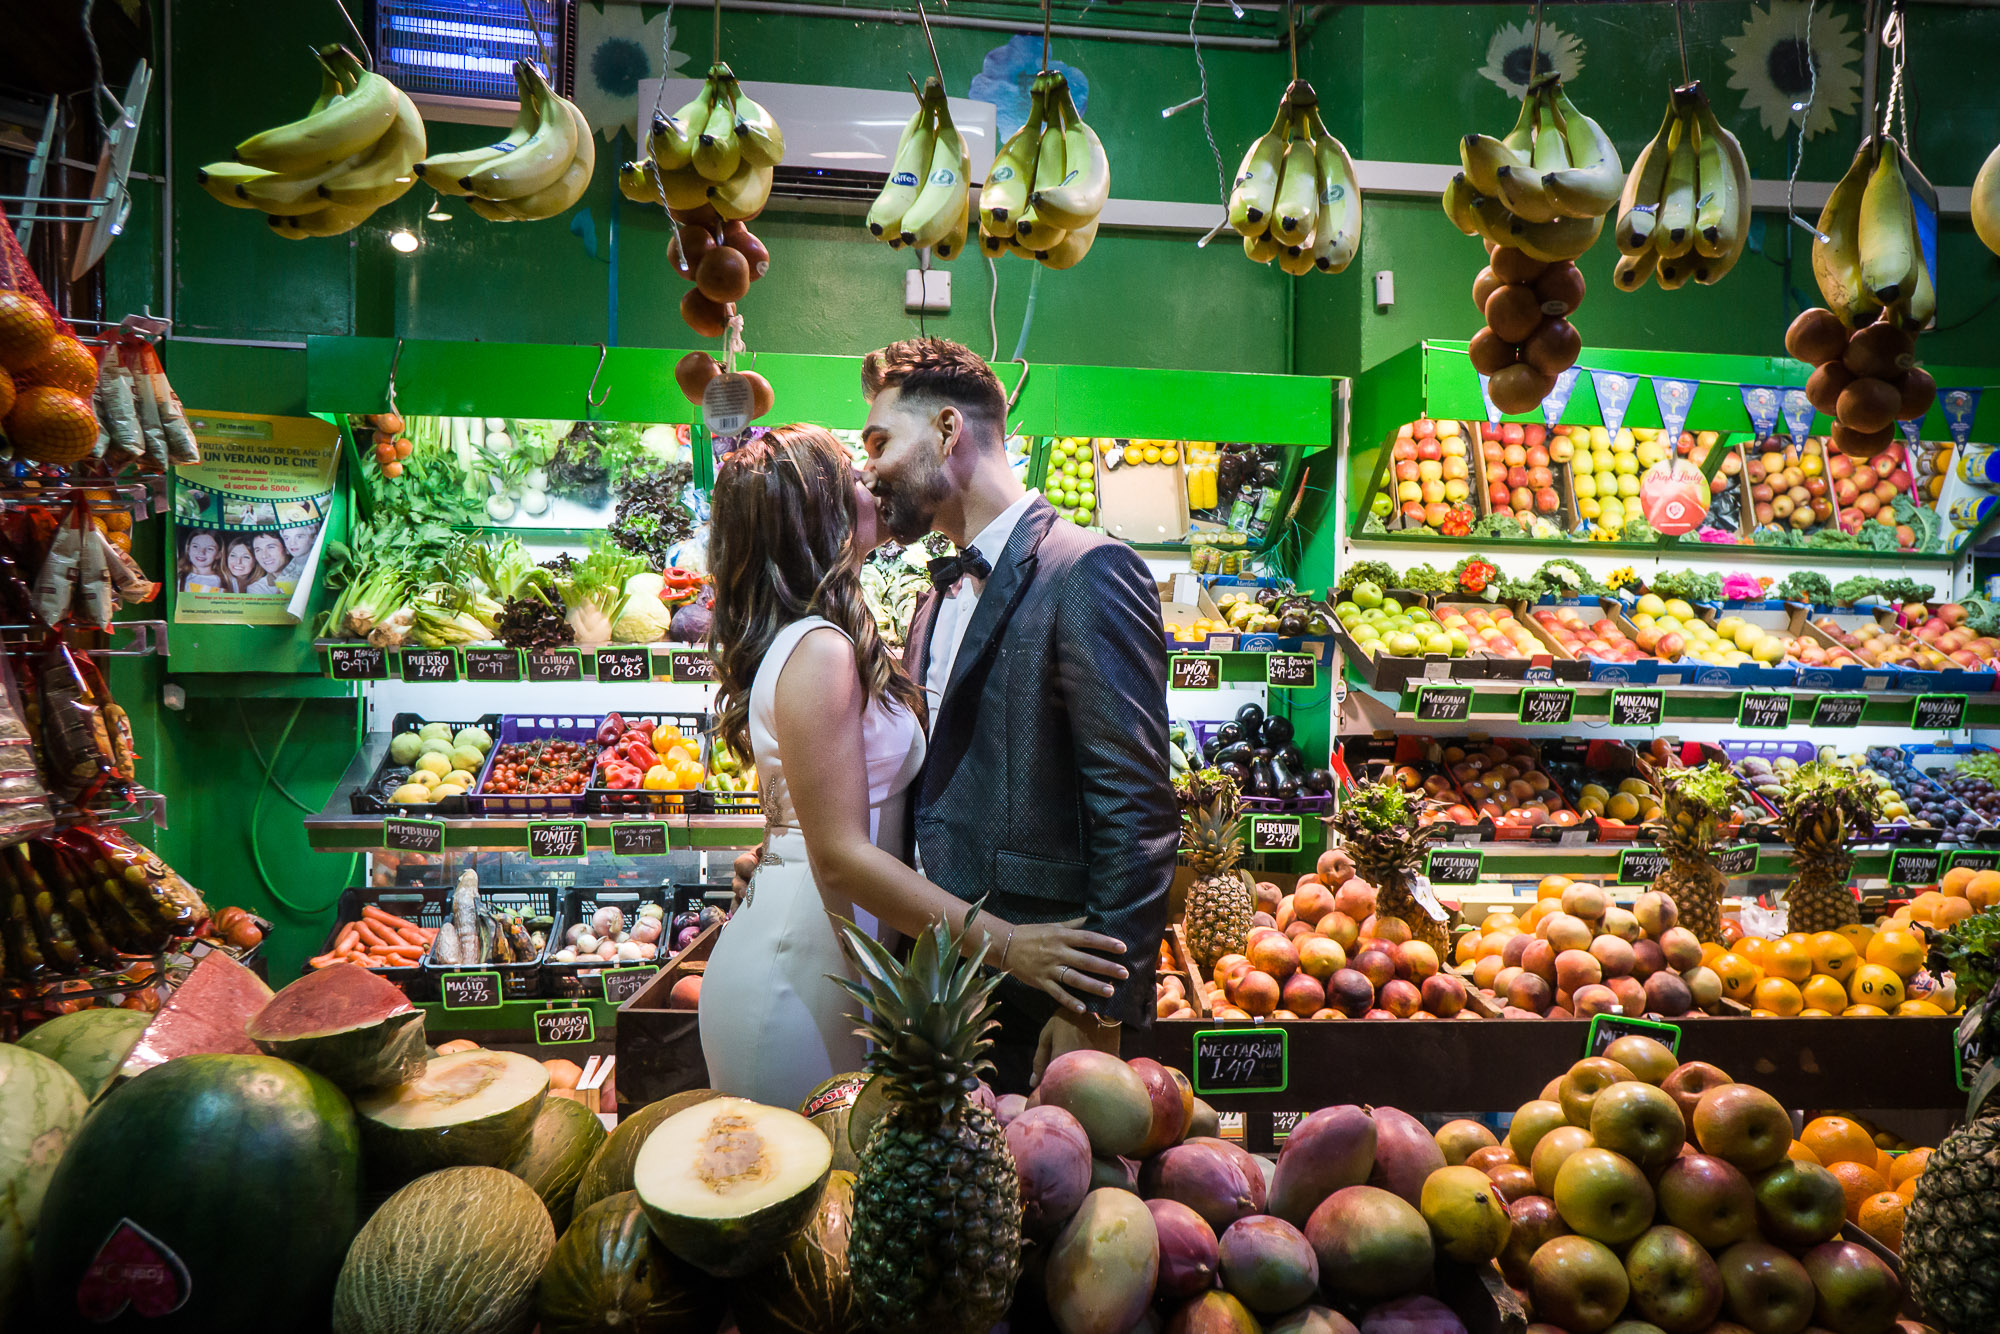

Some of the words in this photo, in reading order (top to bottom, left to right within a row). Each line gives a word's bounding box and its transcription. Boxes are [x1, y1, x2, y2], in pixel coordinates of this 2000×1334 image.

[226, 444, 245, 452] CON
[247, 445, 255, 453] EL
[257, 446, 284, 455] SABOR
[287, 448, 300, 456] DEL
[302, 448, 321, 457] AÑO
[204, 452, 220, 462] UN
[224, 453, 270, 465] VERANO
[274, 456, 288, 466] DE
[292, 458, 318, 468] CINE
[1647, 470, 1673, 483] Pink
[408, 656, 449, 666] PUERRO
[598, 654, 618, 664] COL
[674, 656, 691, 665] COL
[418, 666, 445, 677] 1.49
[542, 664, 570, 676] 0.99
[611, 663, 644, 678] 0.85
[1184, 675, 1210, 686] 1.25
[1422, 692, 1466, 704] MANZANA
[1538, 692, 1570, 701] MANZANA
[1615, 695, 1659, 709] MANZANA
[1432, 704, 1459, 718] 1.99
[1529, 700, 1566, 712] KANZI
[1744, 698, 1788, 711] MANZANA
[1819, 703, 1862, 713] MANZANA
[1918, 702, 1961, 714] MANZANA
[1752, 712, 1779, 726] 1.99
[1924, 714, 1957, 728] 2.25
[388, 824, 440, 838] MIMBRILLO
[533, 830, 580, 844] TOMATE
[400, 836, 434, 848] 2.49
[624, 834, 652, 848] 2.99
[1265, 834, 1295, 847] 2.49
[544, 842, 576, 856] 3.99
[1431, 856, 1480, 868] NECTARINA
[1954, 858, 1992, 868] CIRUELA
[1442, 867, 1474, 880] 2.49
[1634, 866, 1664, 878] 2.49
[446, 982, 484, 992] MACHO
[458, 990, 491, 1003] 2.75
[538, 1015, 589, 1027] CALABASA
[550, 1024, 585, 1041] 0.99
[1211, 1058, 1256, 1081] 1.49
